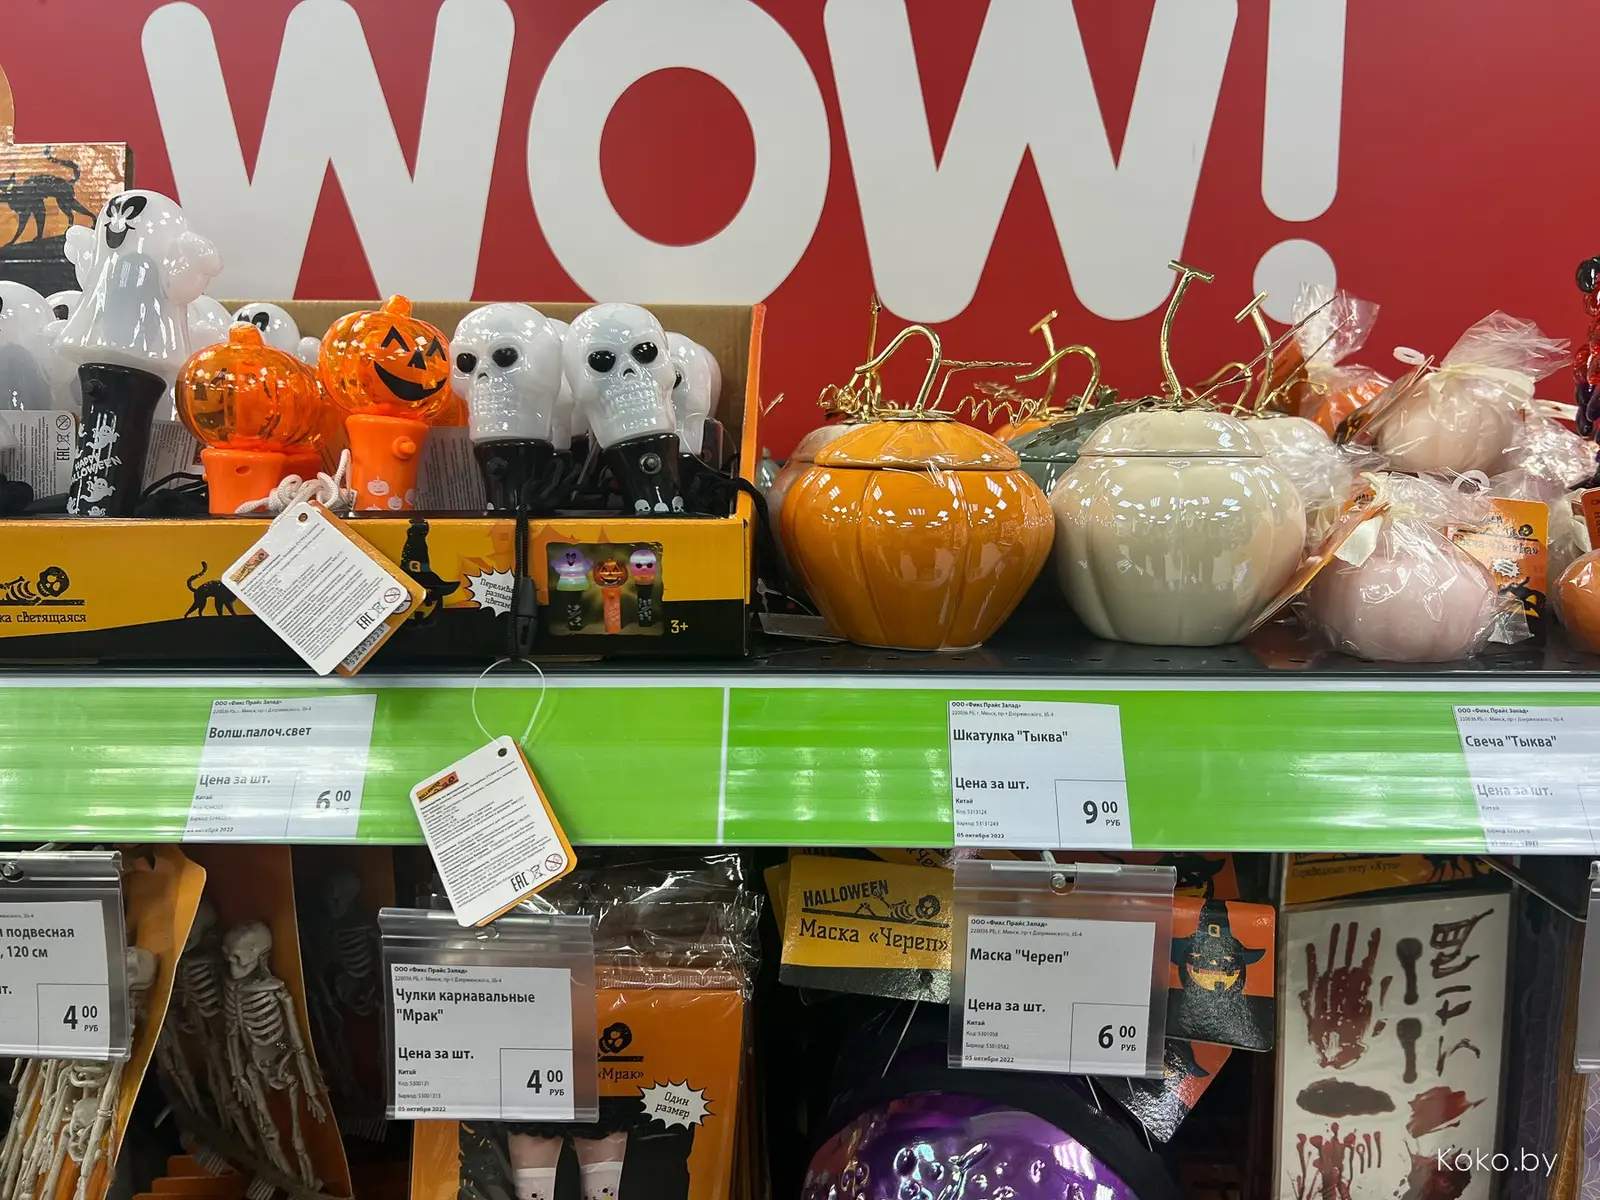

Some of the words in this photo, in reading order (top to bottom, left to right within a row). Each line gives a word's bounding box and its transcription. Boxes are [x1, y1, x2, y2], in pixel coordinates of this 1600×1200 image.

[141, 0, 1345, 324] WOW!
[670, 620, 689, 634] 3+
[209, 727, 312, 739] Волш.палоч.свет
[954, 729, 1014, 744] Шкатулка
[1017, 730, 1068, 742] "Тыква"
[1466, 736, 1504, 748] Свеча
[1506, 736, 1557, 748] "Тыква"
[200, 774, 230, 787] Цена
[234, 776, 246, 784] за
[250, 775, 271, 784] шт.
[955, 777, 987, 790] Цена
[990, 780, 1004, 790] за
[1008, 780, 1030, 790] шт.
[335, 790, 352, 802] 00
[1477, 784, 1511, 798] Цена
[1513, 787, 1528, 796] за
[1531, 786, 1553, 796] шт.
[316, 790, 331, 812] 6
[1102, 801, 1118, 814] 00
[1082, 800, 1098, 824] 9
[803, 880, 888, 907] HALLOWEEN
[6, 928, 74, 940] подвесная
[800, 918, 860, 942] Маска
[868, 927, 948, 954] «Череп»
[6, 946, 29, 958] 120
[32, 948, 48, 958] см
[970, 948, 1012, 962] Маска
[1015, 949, 1070, 965] "Череп"
[396, 988, 436, 1003] Чулки
[439, 992, 536, 1006] карнавальные
[82, 1005, 98, 1018] 00
[968, 998, 1002, 1013] Цена
[1005, 1002, 1020, 1012] за
[1023, 1002, 1046, 1012] шт.
[63, 1005, 78, 1030] 4
[396, 1008, 444, 1024] "Мрак"
[1098, 1024, 1114, 1048] 6
[1119, 1026, 1136, 1038] 00
[398, 1047, 432, 1060] Цена
[434, 1050, 448, 1058] за
[452, 1050, 474, 1060] шт.
[526, 1070, 542, 1094] 4
[547, 1070, 563, 1082] 00
[664, 1091, 690, 1106] Один
[654, 1103, 690, 1120] размер
